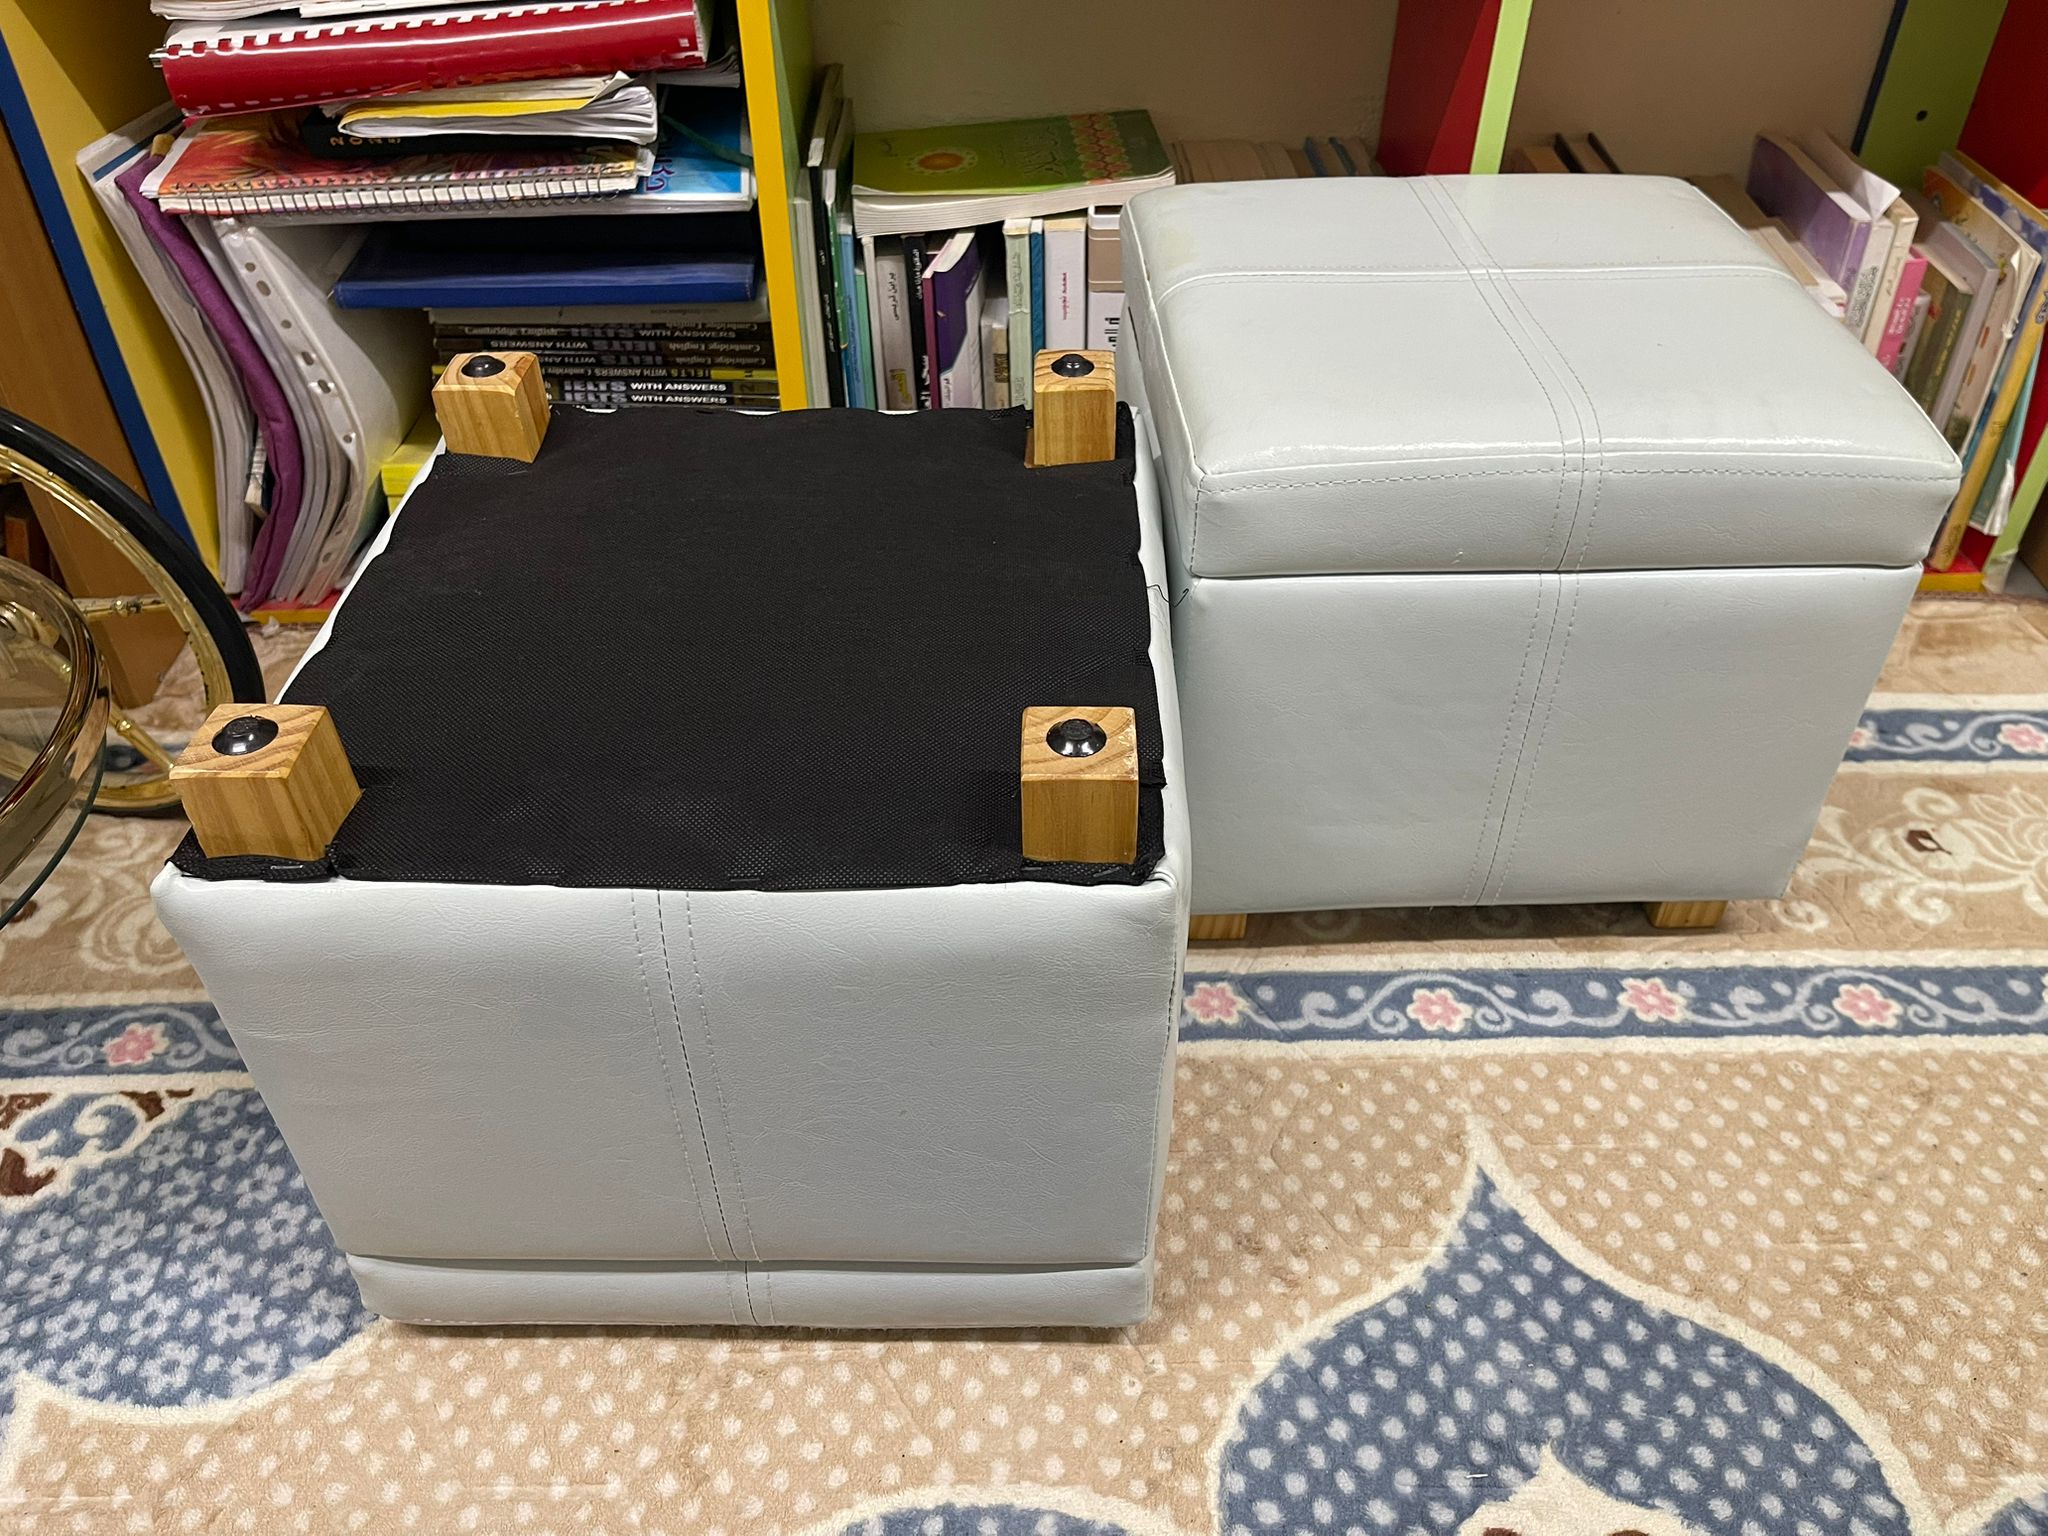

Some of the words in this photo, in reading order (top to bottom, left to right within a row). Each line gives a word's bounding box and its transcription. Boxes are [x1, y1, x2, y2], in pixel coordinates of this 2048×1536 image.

[464, 327, 518, 336] Cambridge
[520, 327, 559, 337] English
[673, 330, 737, 338] ANSWERS
[490, 341, 554, 349] ANSWERS
[556, 341, 589, 349] WITH
[592, 340, 656, 351] IELTS
[668, 342, 705, 352] English
[708, 342, 761, 352] Cambridge
[564, 356, 597, 364] WITH
[600, 355, 663, 366] IELTS
[675, 355, 711, 366] English
[713, 356, 766, 366] Cambridge
[594, 367, 641, 377] ANSWERS
[641, 368, 668, 377] WITH
[671, 368, 710, 377] IELTS
[563, 380, 627, 391] IELTS
[630, 382, 663, 390] WITH
[664, 383, 727, 392] ANSWERS
[563, 392, 628, 403] IELTS
[631, 394, 664, 402] WITH
[665, 396, 728, 405] ANSWERS
